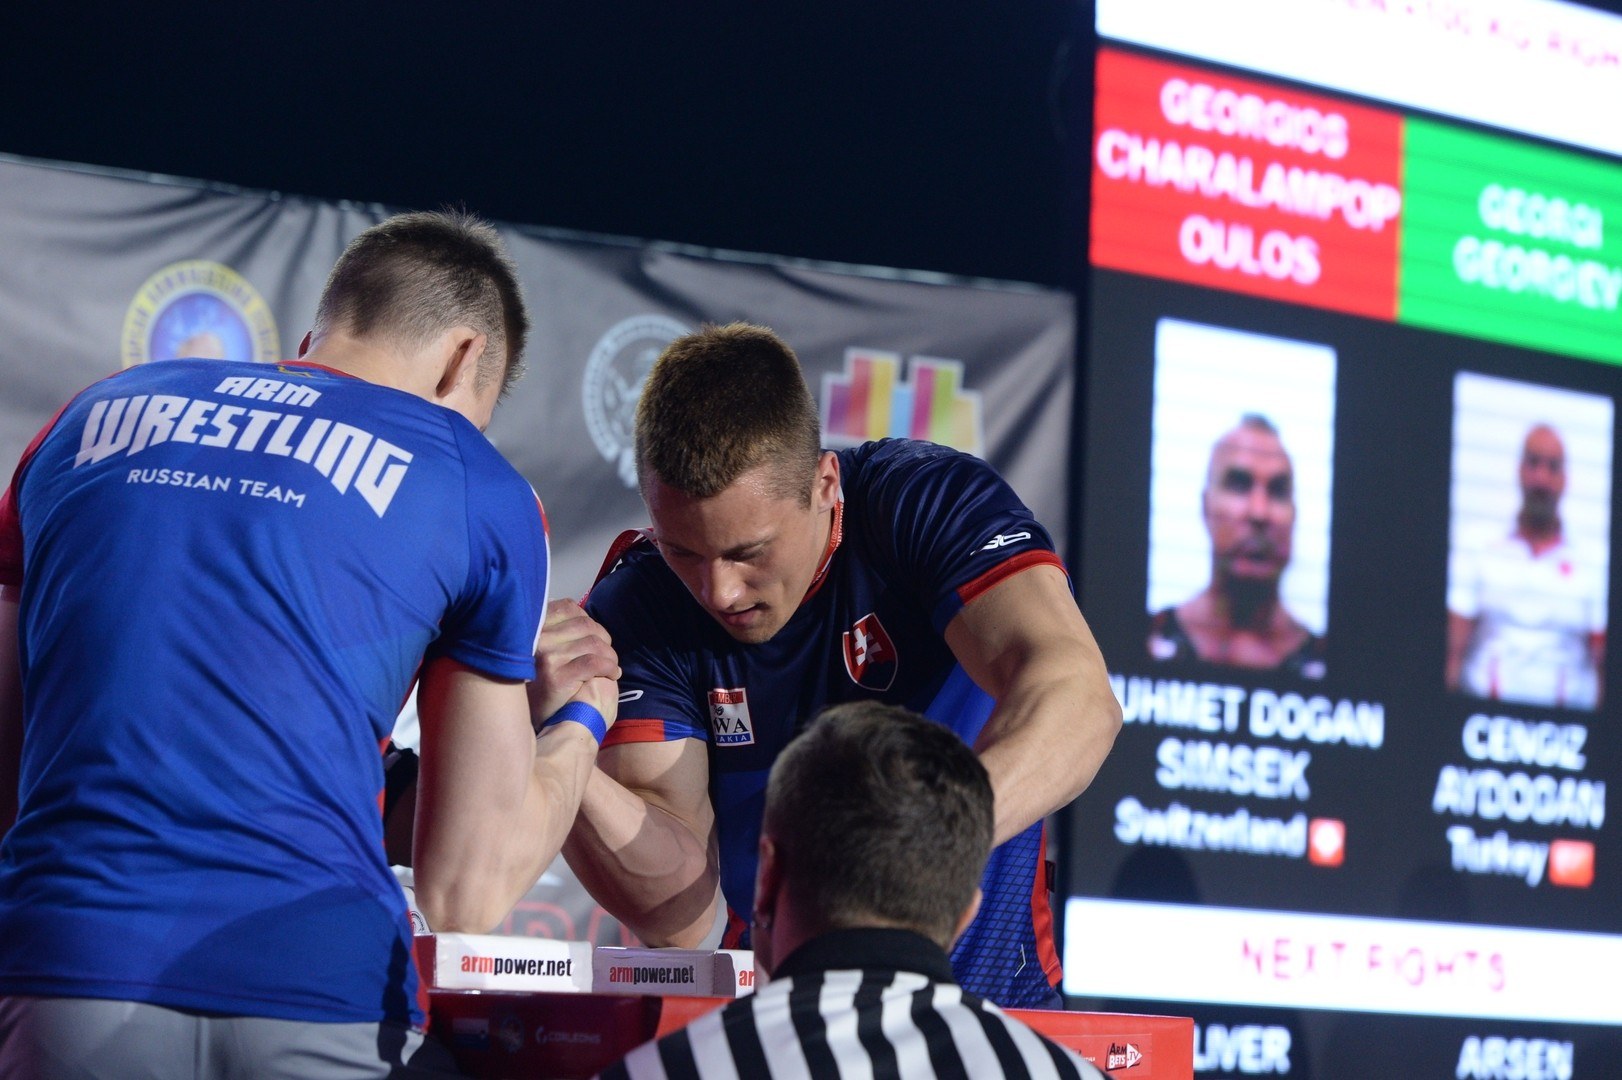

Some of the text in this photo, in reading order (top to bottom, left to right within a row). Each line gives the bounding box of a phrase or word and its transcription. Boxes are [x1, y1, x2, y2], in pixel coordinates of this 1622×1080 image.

[1160, 78, 1349, 159] GEORGIOS
[1097, 128, 1402, 232] CHARALAMPOP
[1478, 183, 1604, 249] GEORGI
[1179, 214, 1321, 286] OULOS
[214, 377, 322, 407] ARM
[73, 394, 414, 519] WRESTLING
[126, 468, 306, 508] RUSSIAN TEAM
[718, 735, 748, 743] AKIA
[1248, 687, 1385, 749] DOGAN
[1461, 713, 1588, 772] CENGIZ
[1156, 737, 1312, 802] SIMSEK
[1432, 765, 1606, 829] AYDOGAN
[1114, 796, 1307, 858] Switzerland
[1447, 825, 1549, 887] Turkey
[461, 955, 572, 977] armpower.net
[610, 964, 695, 985] armpower.net
[1241, 937, 1507, 992] NEXT FIGHTS
[1456, 1035, 1574, 1080] ARSEN
